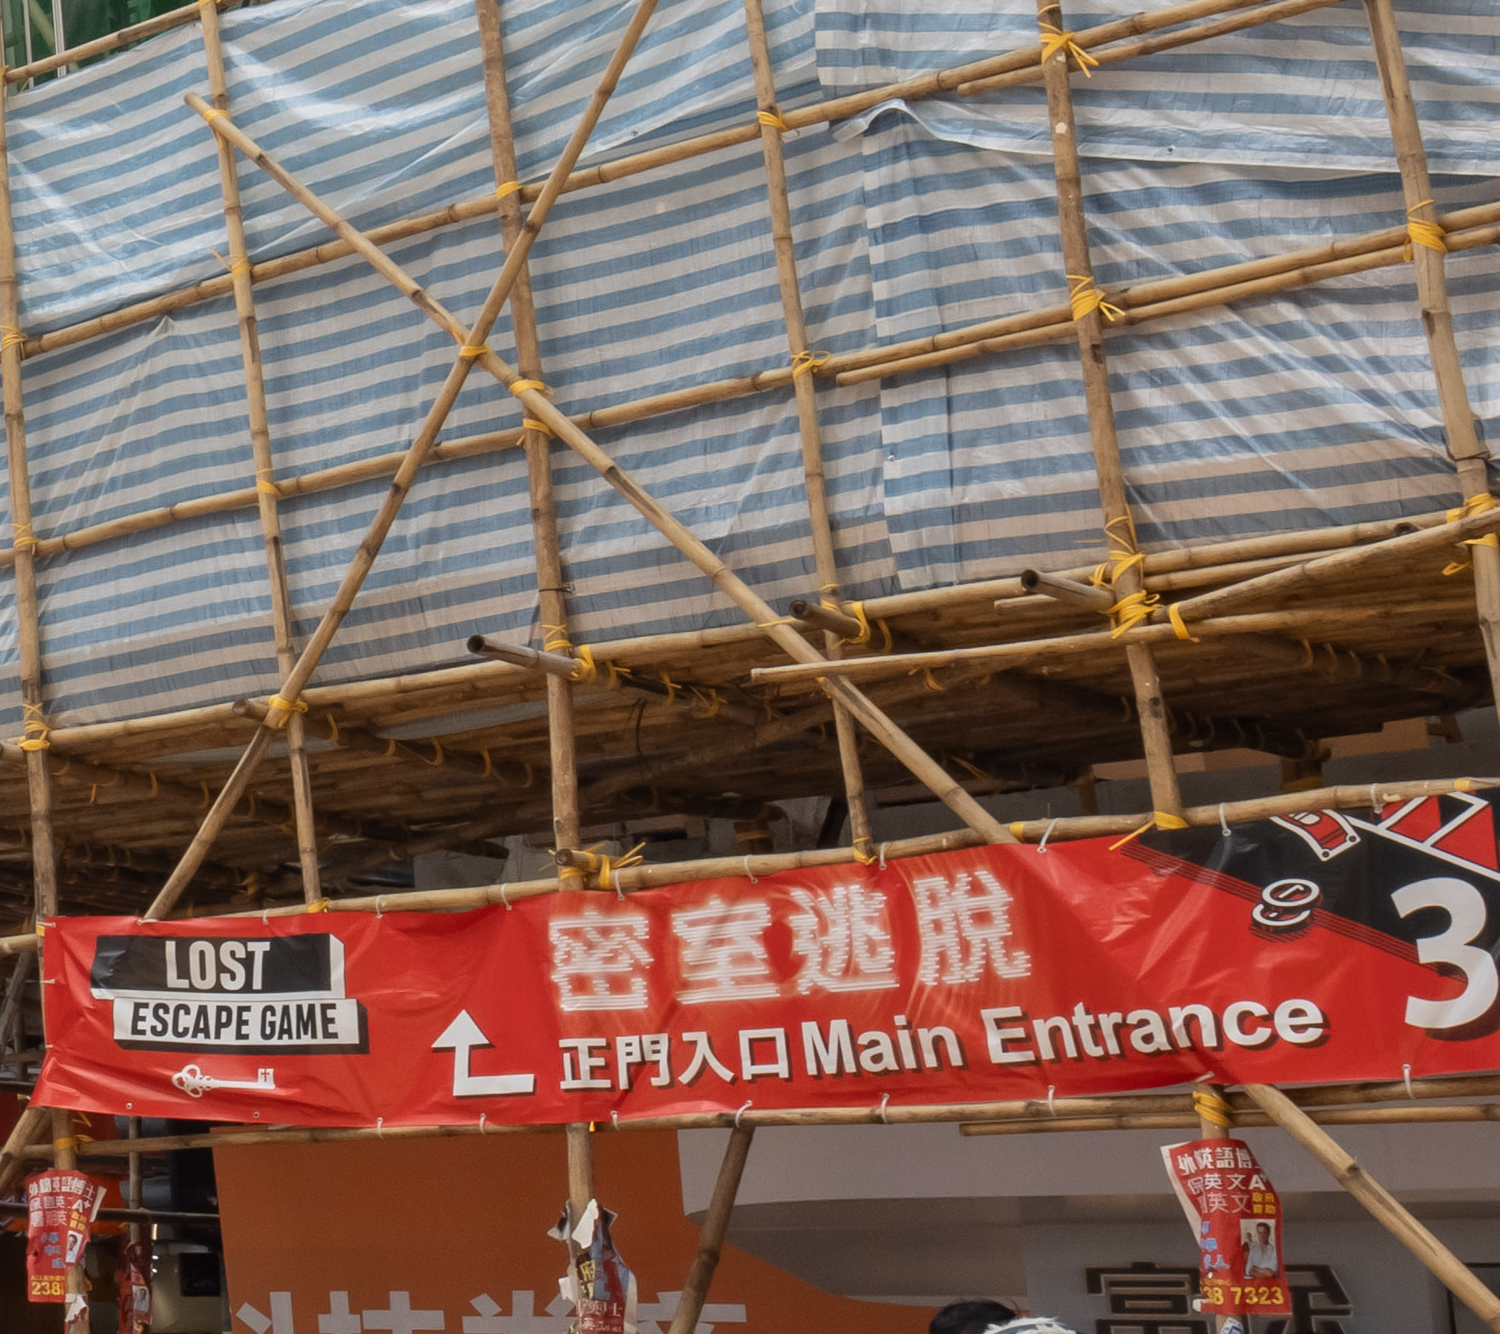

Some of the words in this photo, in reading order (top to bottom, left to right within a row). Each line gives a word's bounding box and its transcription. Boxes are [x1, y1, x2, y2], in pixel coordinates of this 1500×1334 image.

[165, 940, 271, 991] LOST
[131, 1001, 250, 1040] ESCAPE
[260, 1003, 340, 1041] GAME
[558, 1027, 789, 1091] 正門入口
[801, 1016, 962, 1077] Main
[980, 997, 1324, 1066] Entrance
[1230, 1285, 1285, 1306] 7323
